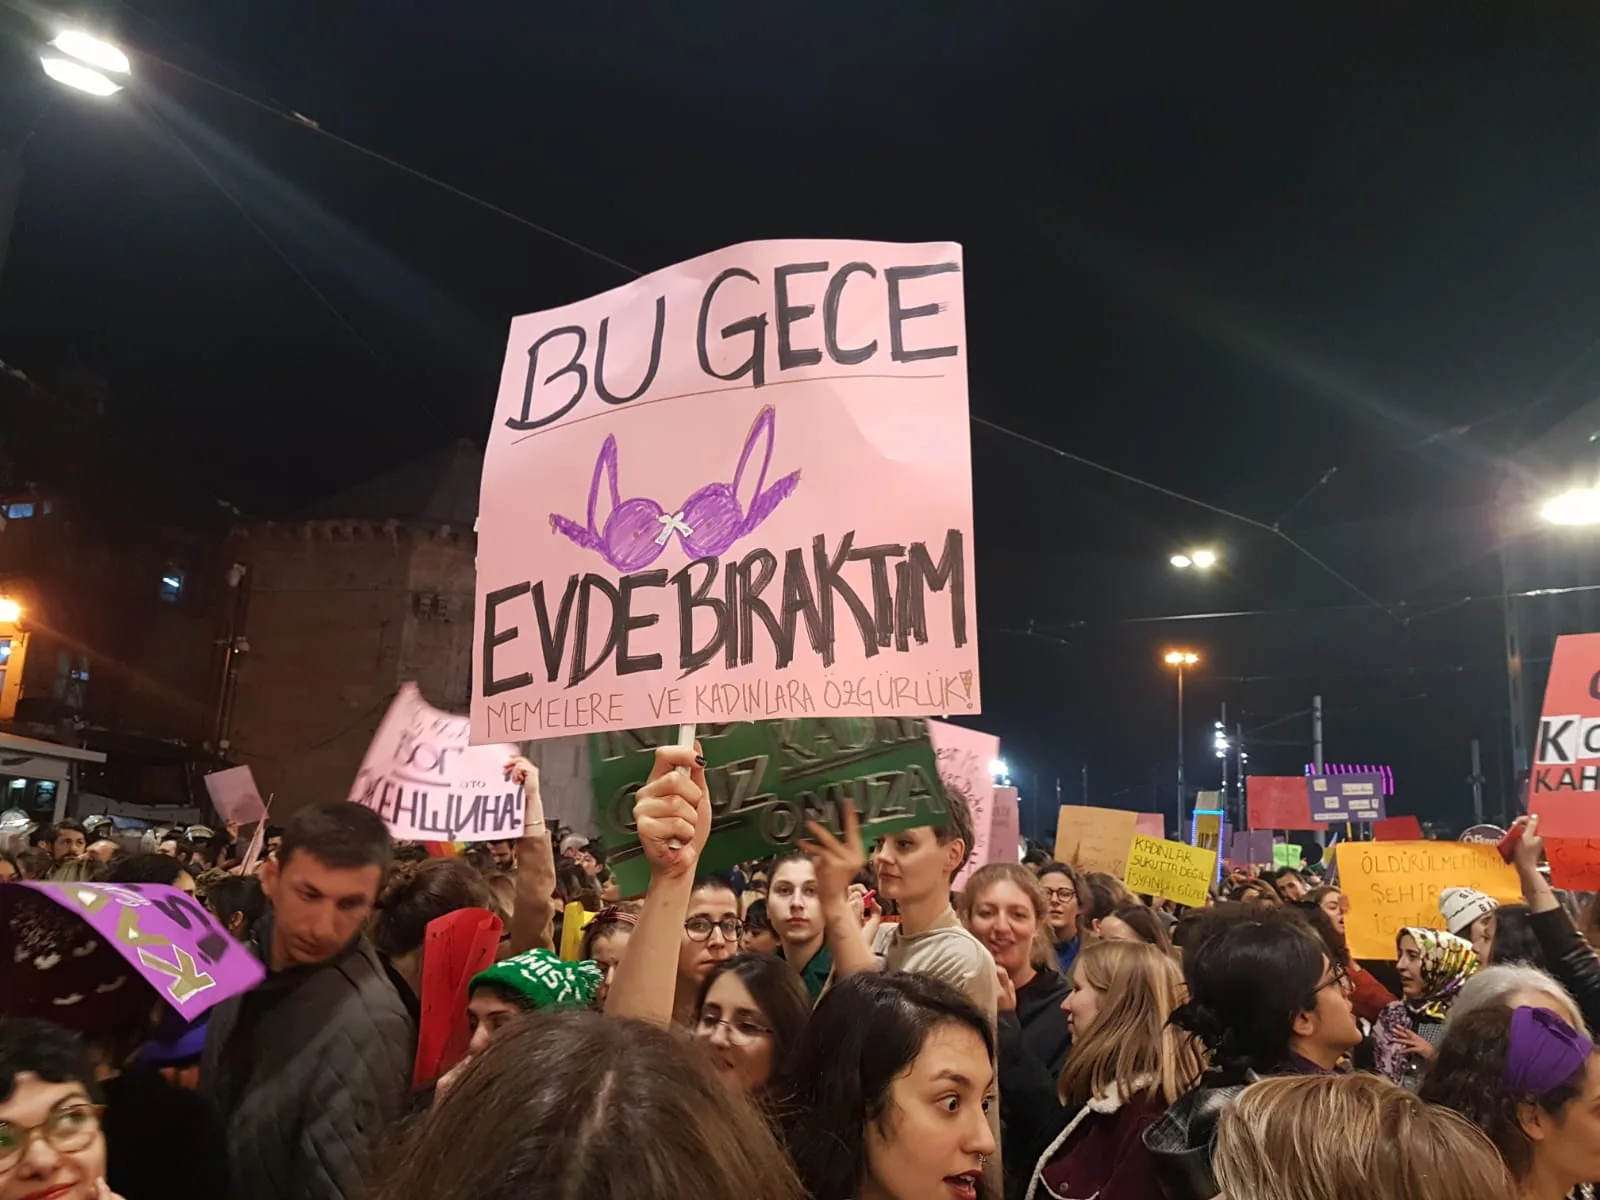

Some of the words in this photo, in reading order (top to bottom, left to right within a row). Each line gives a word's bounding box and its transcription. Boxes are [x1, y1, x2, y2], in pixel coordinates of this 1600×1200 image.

[505, 296, 665, 430] BU
[697, 260, 960, 388] GECE
[483, 568, 668, 697] EVDE
[666, 528, 967, 680] BIRAKTIM
[487, 692, 624, 738] MEMELERE
[648, 686, 681, 719] VE
[695, 677, 816, 715] KADINLARA
[823, 669, 973, 714] ÖZGÜRLÜK!
